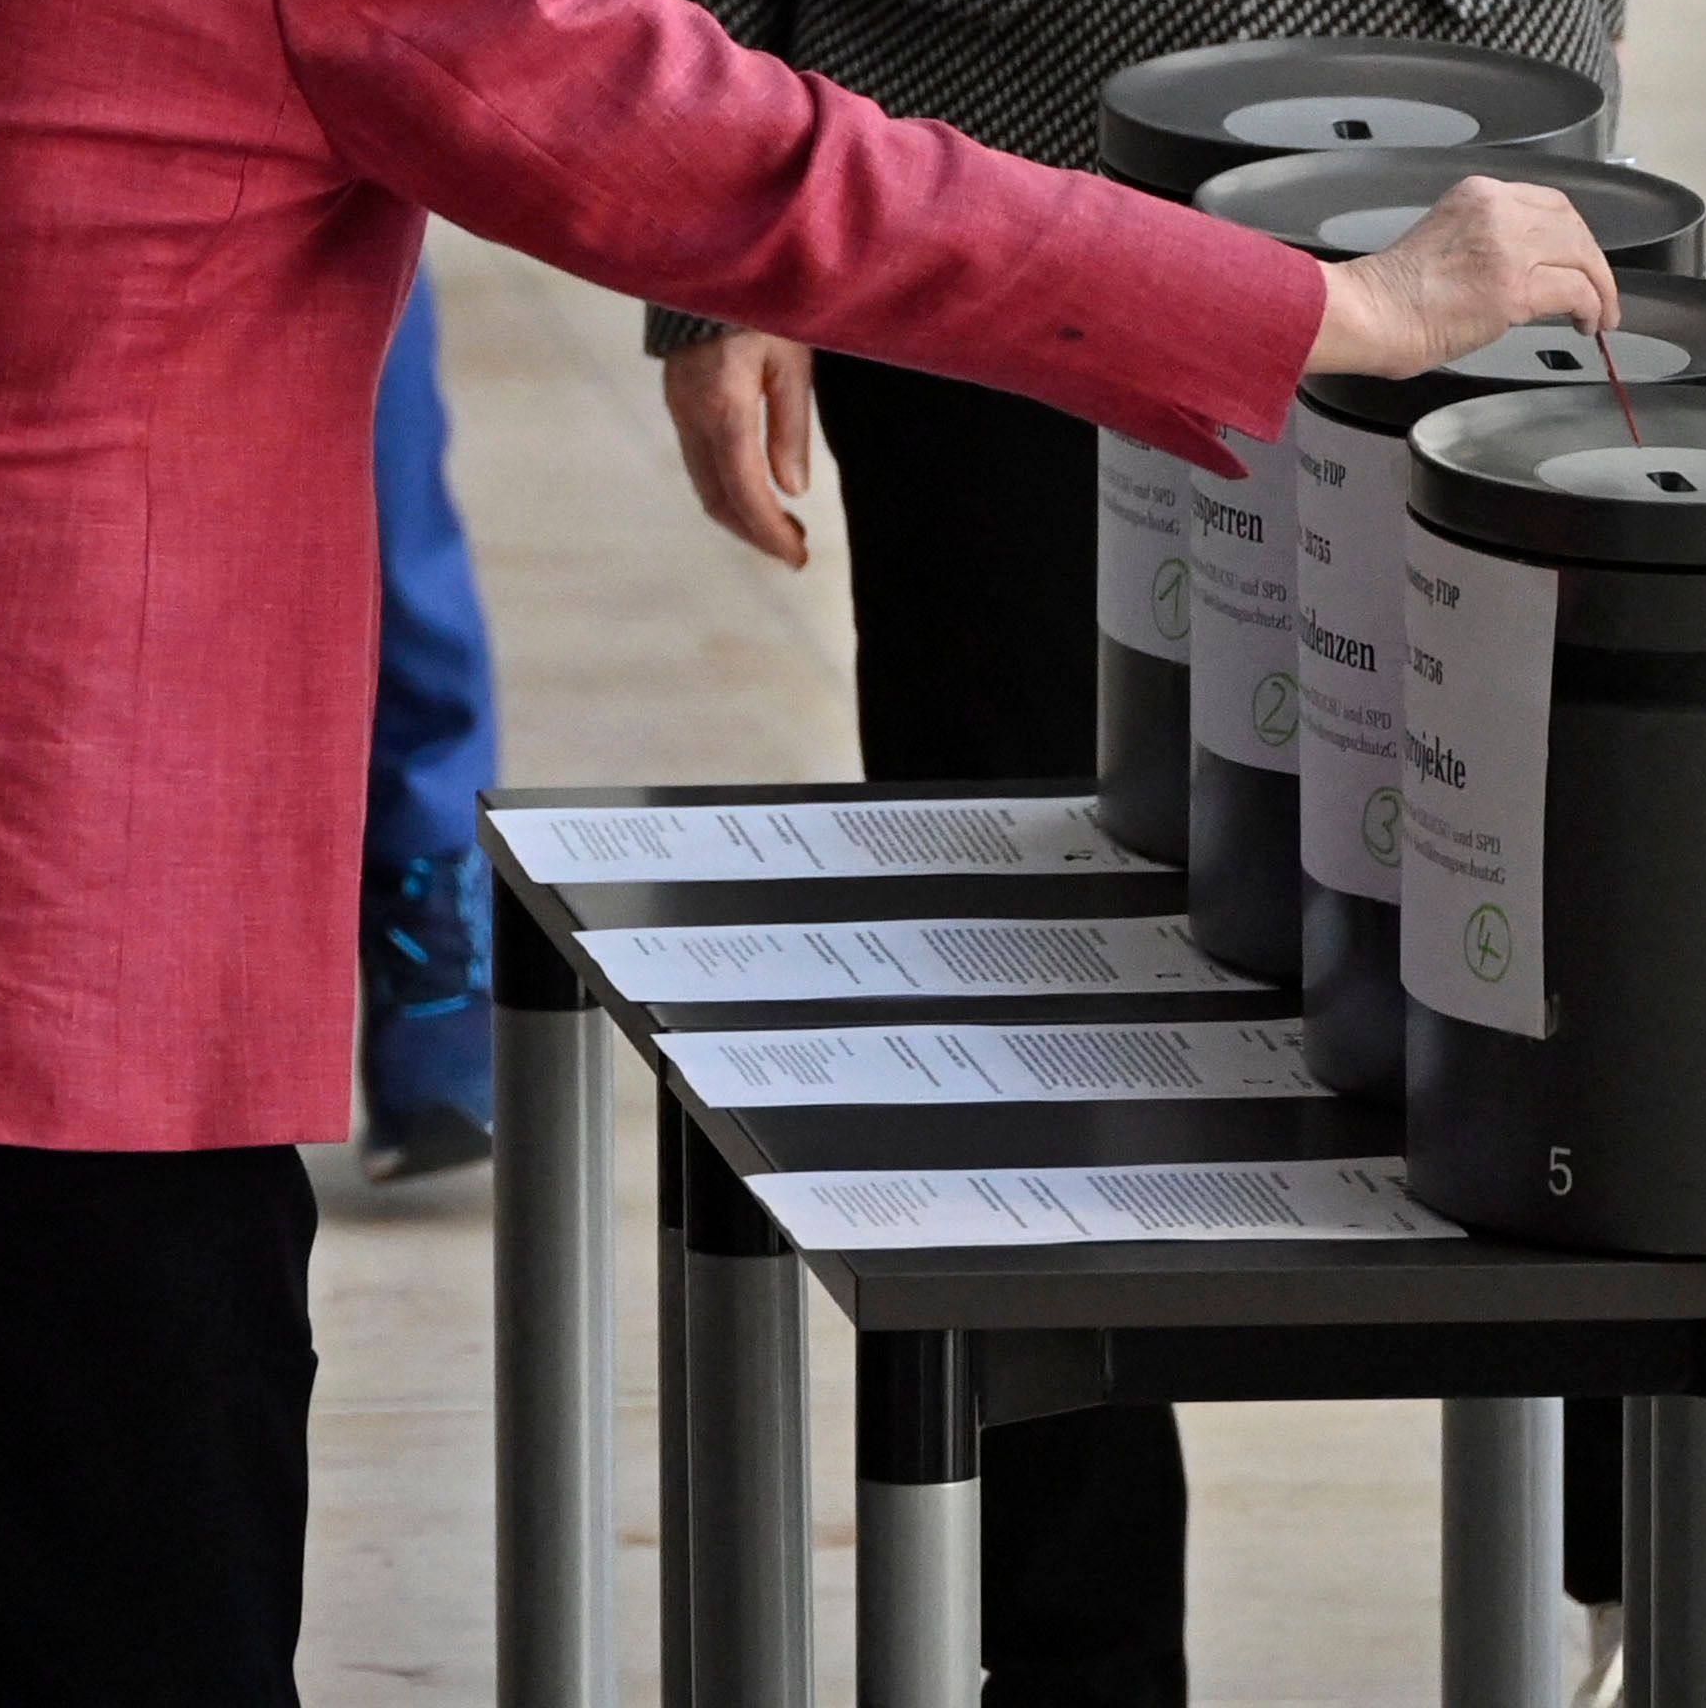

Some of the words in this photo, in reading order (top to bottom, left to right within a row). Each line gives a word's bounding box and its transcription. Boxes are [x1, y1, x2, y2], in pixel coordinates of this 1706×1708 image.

[1323, 459, 1347, 489] FDP
[1261, 579, 1288, 603] SPD
[1436, 578, 1461, 610] FDP
[1365, 708, 1392, 731] SPD
[1475, 832, 1502, 856] SPD
[1547, 1144, 1573, 1197] 5
